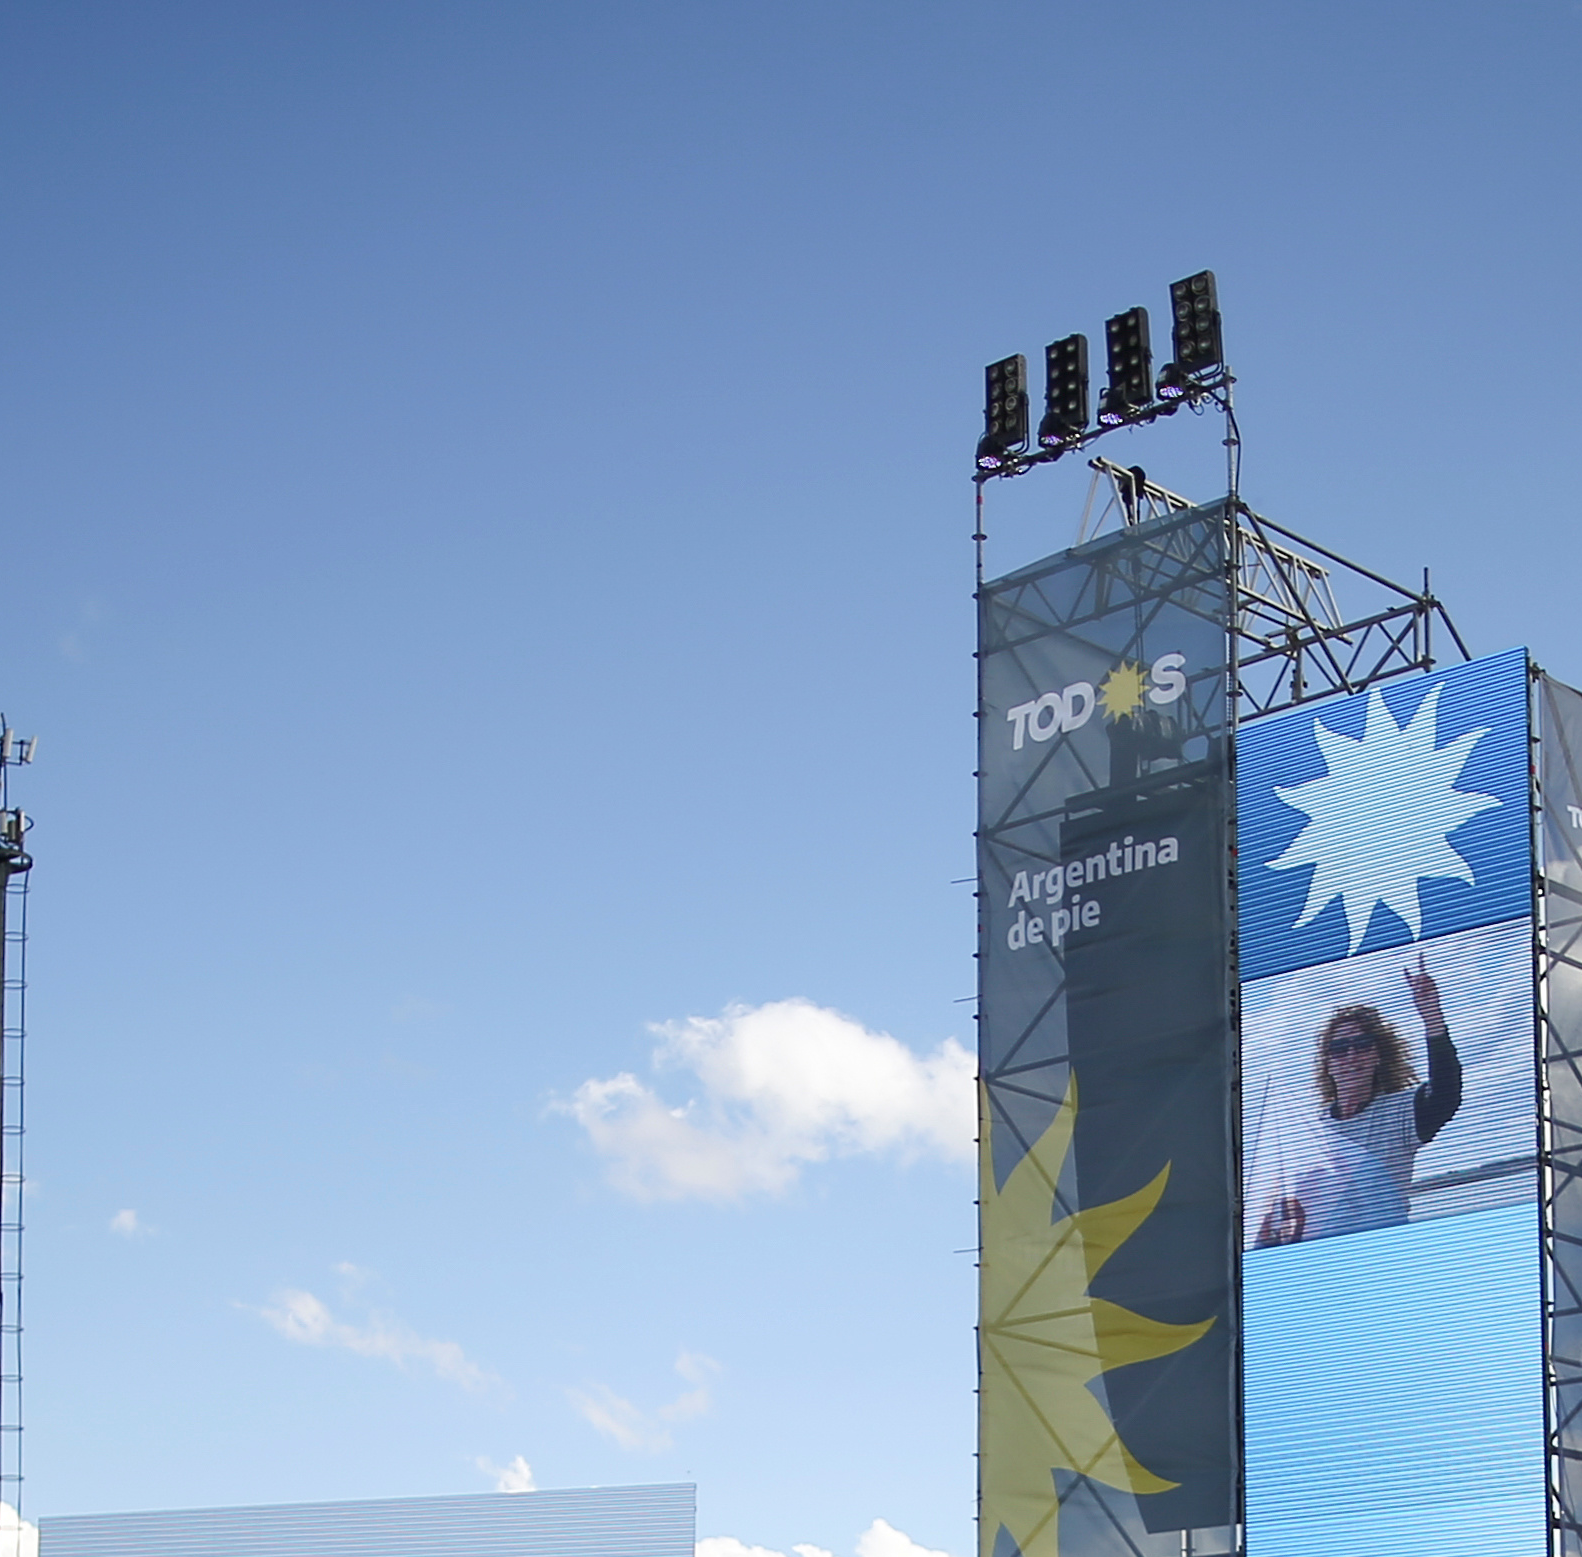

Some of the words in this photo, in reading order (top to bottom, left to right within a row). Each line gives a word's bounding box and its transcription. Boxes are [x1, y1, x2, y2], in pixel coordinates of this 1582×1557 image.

[1007, 835, 1179, 908] Argentina
[1007, 910, 1044, 951] de
[1050, 894, 1101, 947] pie
